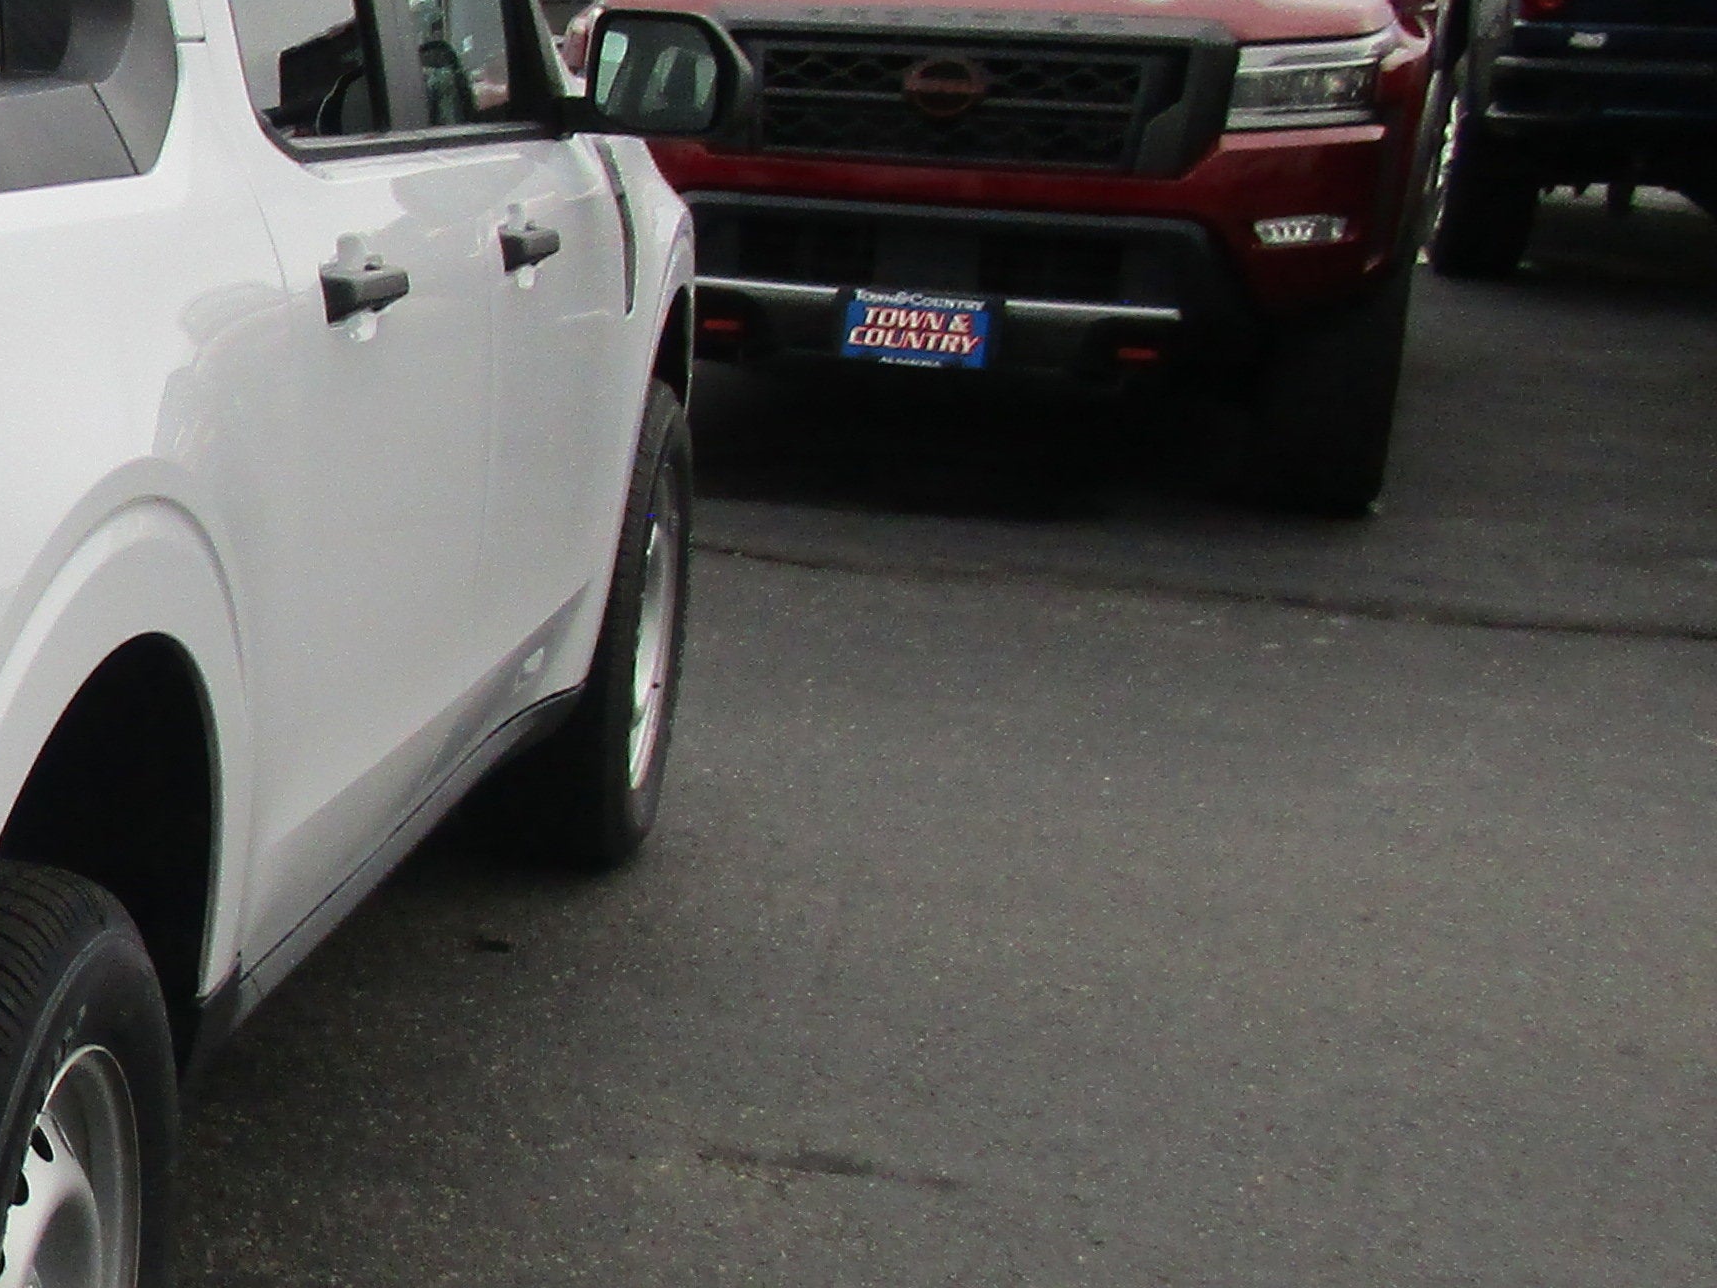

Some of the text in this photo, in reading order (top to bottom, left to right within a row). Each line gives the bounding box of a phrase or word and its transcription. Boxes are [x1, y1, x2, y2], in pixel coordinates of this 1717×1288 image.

[864, 306, 973, 334] TOWN &
[847, 325, 984, 355] COUNTRY
